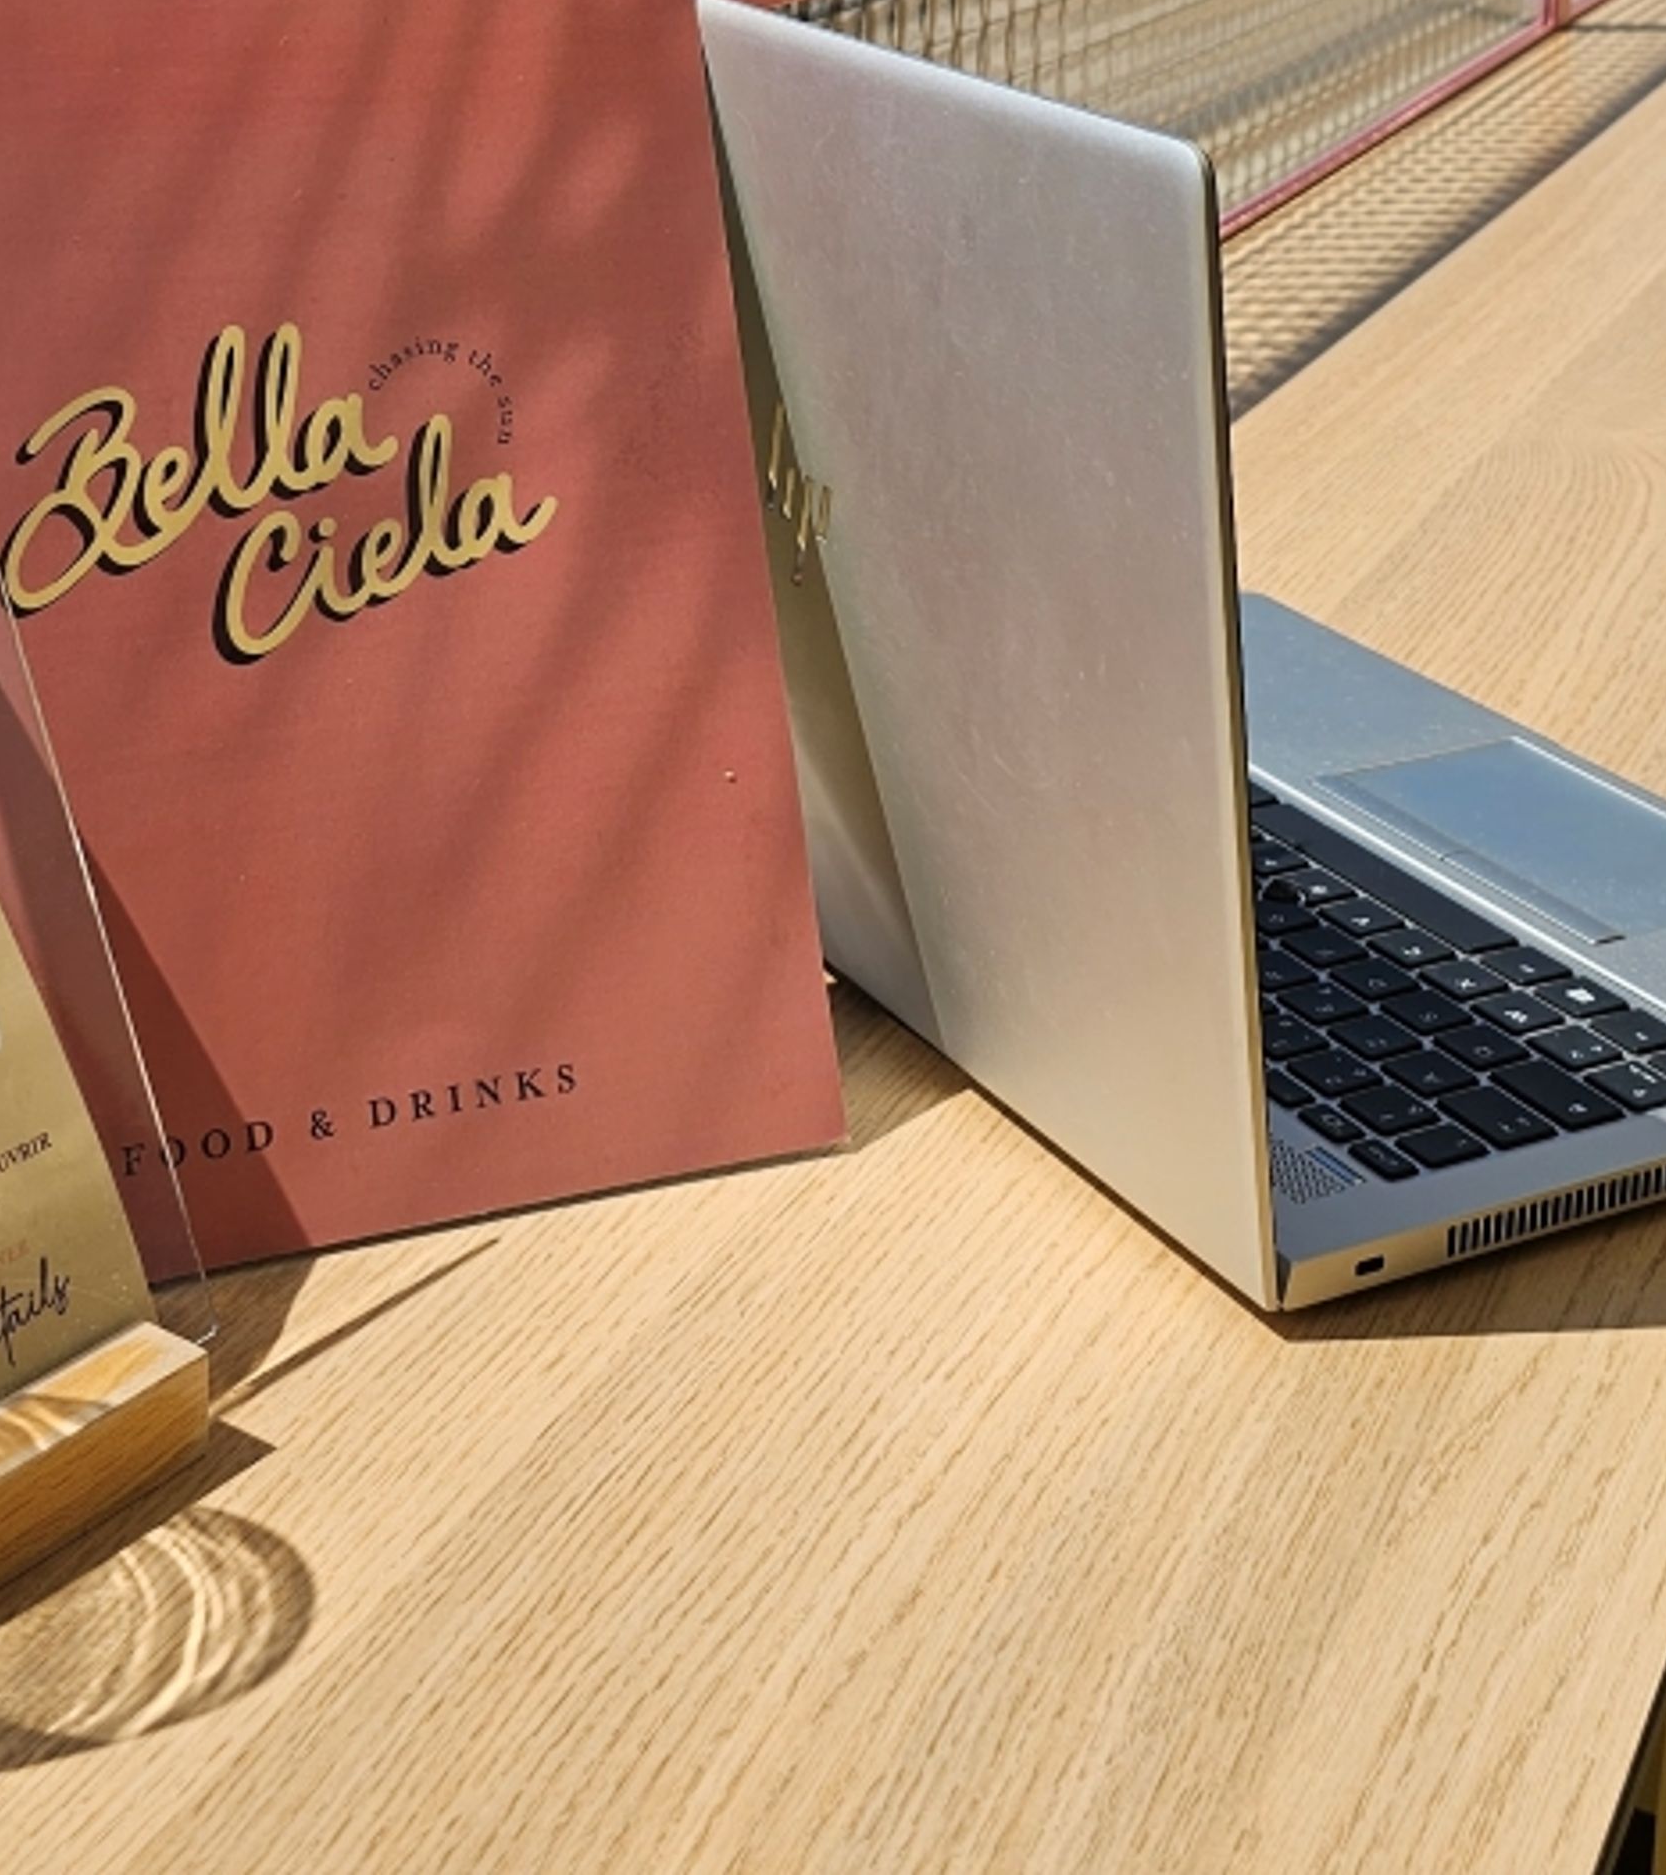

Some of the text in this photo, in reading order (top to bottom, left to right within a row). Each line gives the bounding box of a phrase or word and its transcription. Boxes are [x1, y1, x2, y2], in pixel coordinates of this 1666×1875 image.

[368, 335, 514, 445] chasing the sun
[211, 413, 557, 666] Ciela
[121, 1063, 579, 1177] FOOD & DRINKS
